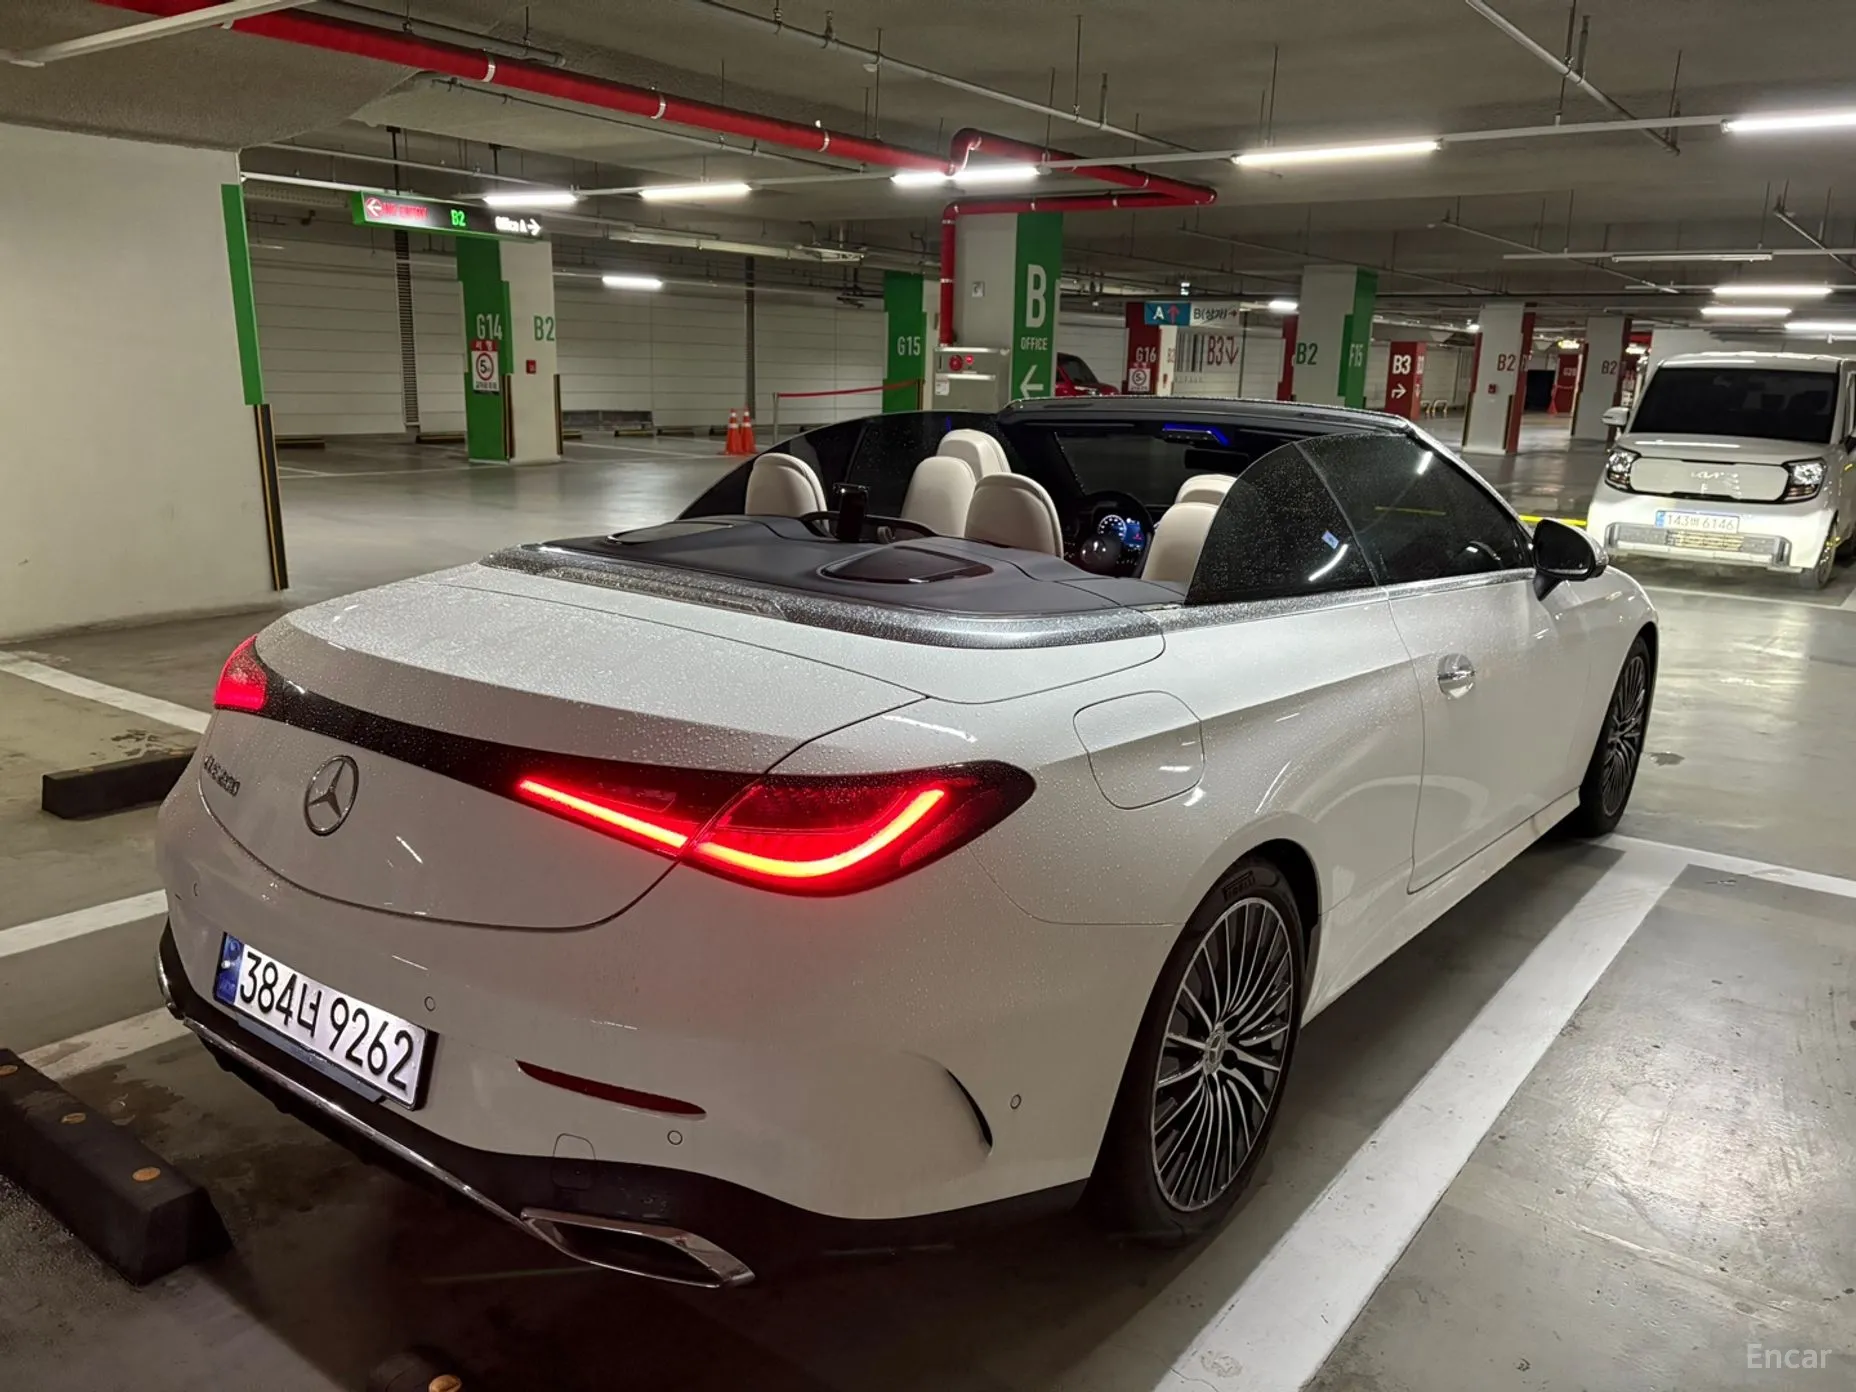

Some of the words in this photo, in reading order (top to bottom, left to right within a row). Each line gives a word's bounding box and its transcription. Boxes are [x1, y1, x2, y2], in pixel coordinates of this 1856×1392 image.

[451, 209, 467, 227] B2
[1026, 264, 1048, 328] B
[1153, 306, 1165, 320] A
[476, 313, 503, 341] G14
[533, 315, 556, 341] B2
[896, 336, 921, 356] G15
[1020, 336, 1048, 350] OFFICE
[1206, 335, 1224, 366] B3
[1135, 346, 1157, 363] G16
[1296, 342, 1319, 366] B2
[1496, 353, 1517, 372] B2
[1391, 354, 1412, 375] B3
[1601, 359, 1618, 375] B2
[240, 951, 323, 1039] 384너
[328, 997, 414, 1091] 9262
